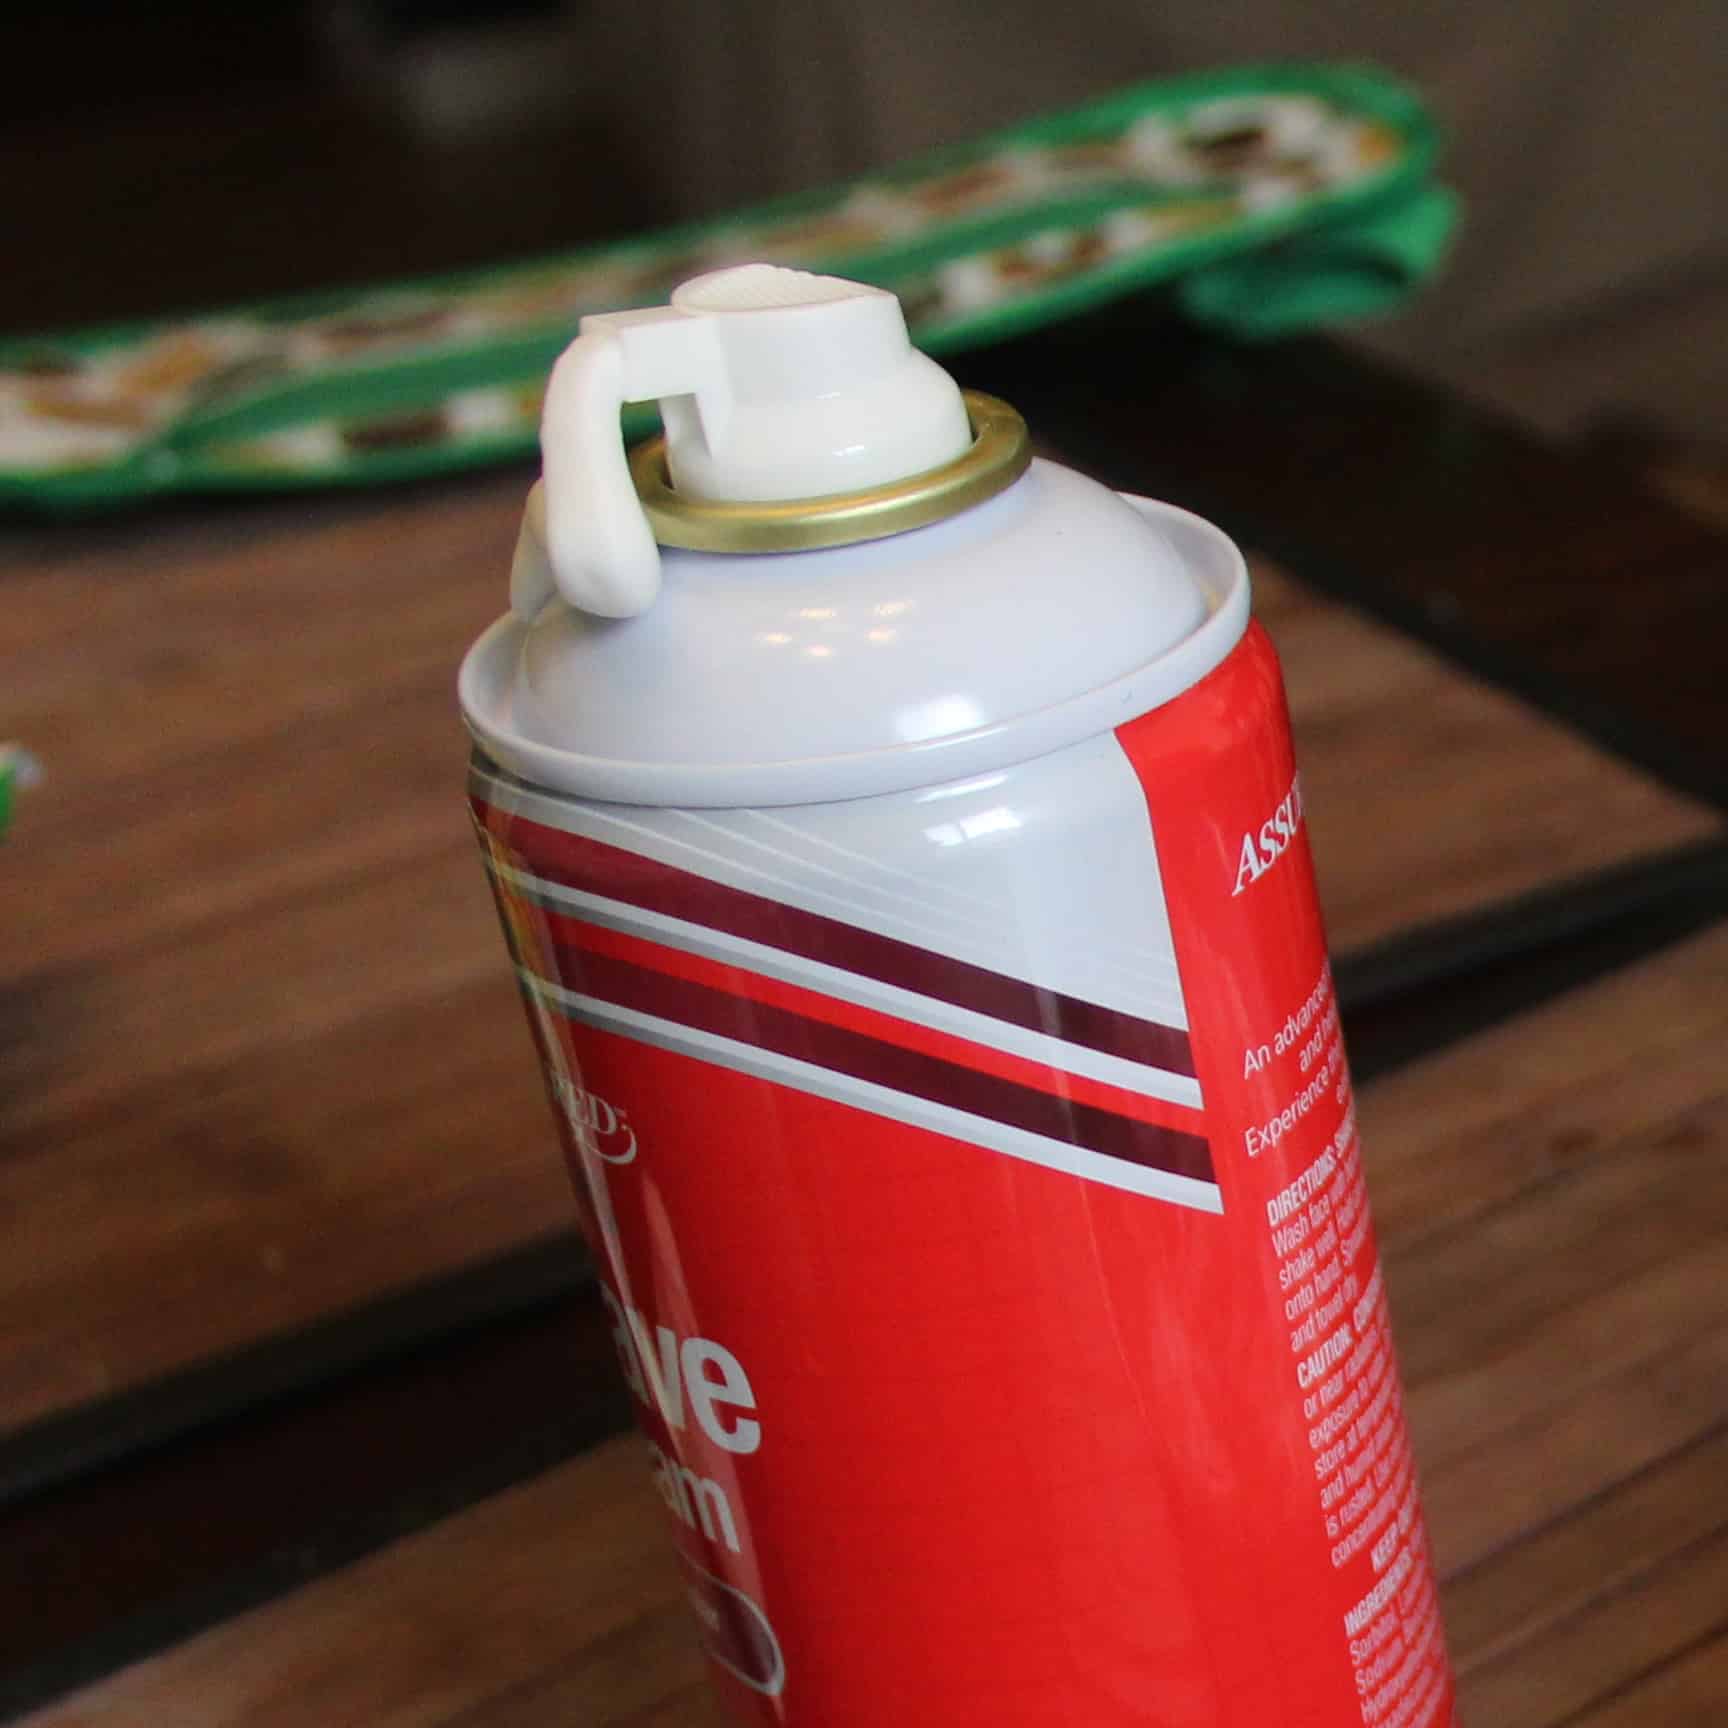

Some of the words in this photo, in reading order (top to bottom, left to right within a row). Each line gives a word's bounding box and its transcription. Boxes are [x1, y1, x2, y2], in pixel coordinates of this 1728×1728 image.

[1243, 1043, 1272, 1082] An
[1300, 1023, 1324, 1073] and
[1244, 1065, 1330, 1159] Experience
[1271, 1211, 1311, 1259] Wash
[1279, 1246, 1317, 1291] shake
[1290, 1311, 1316, 1353] and
[1319, 1468, 1346, 1510] and
